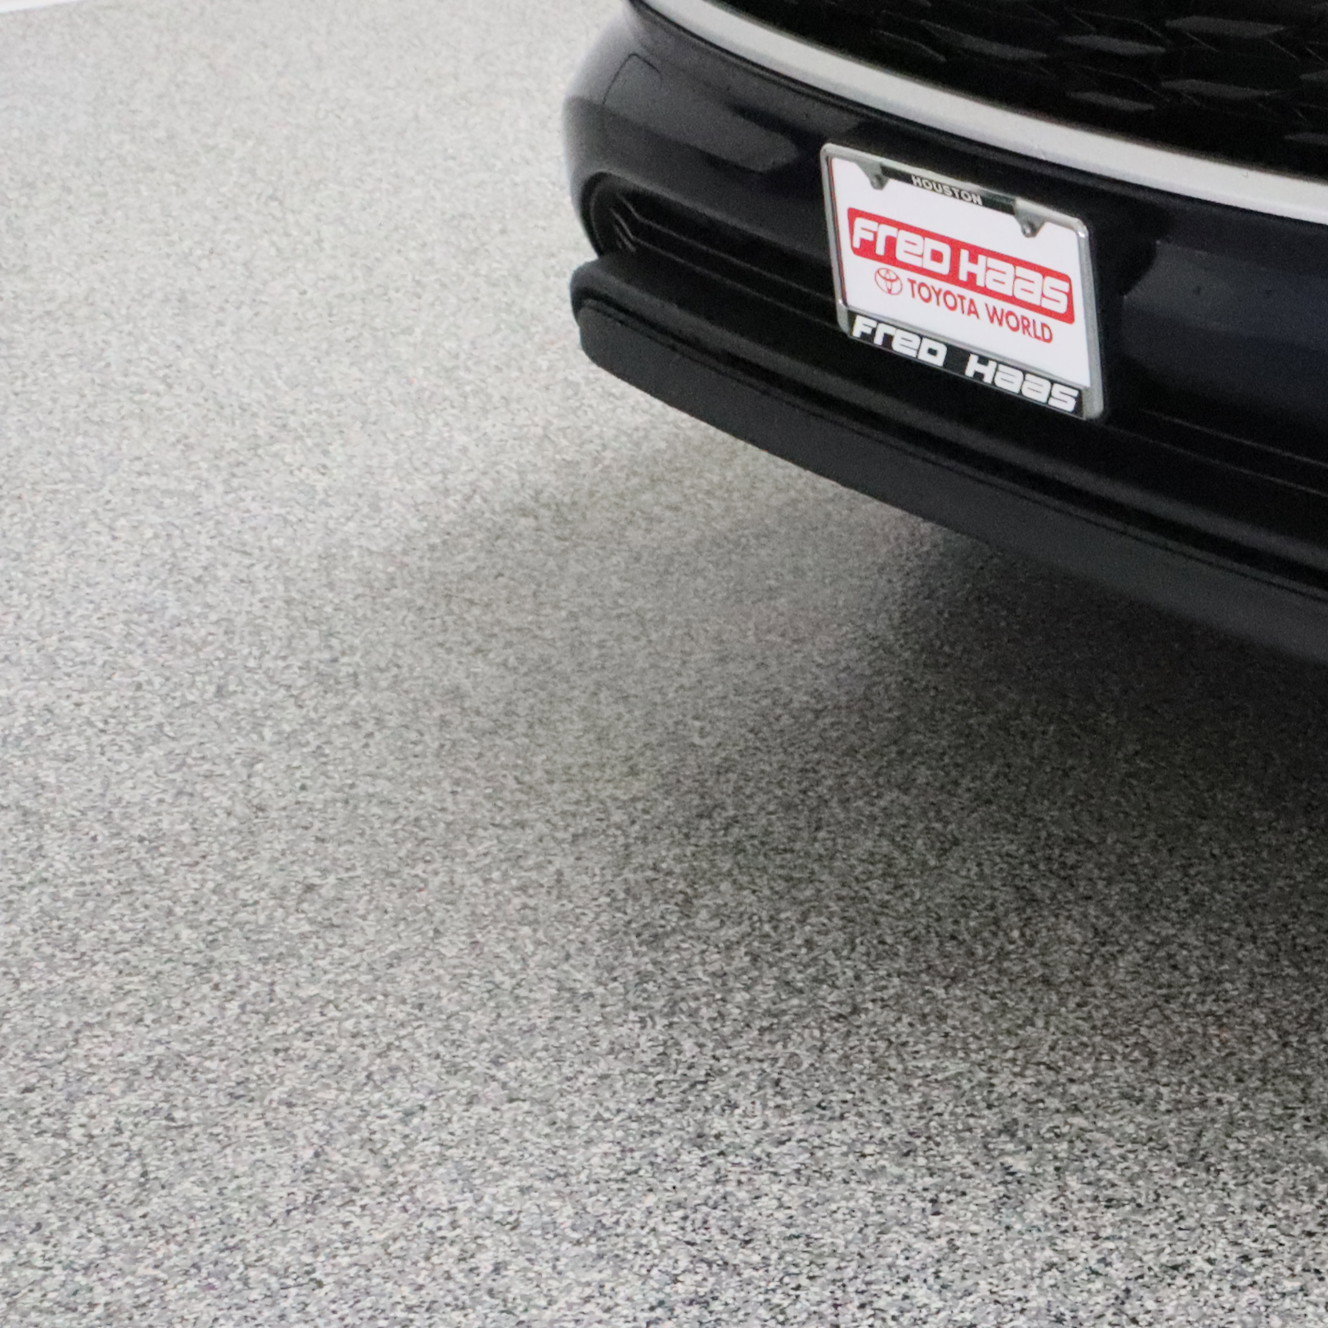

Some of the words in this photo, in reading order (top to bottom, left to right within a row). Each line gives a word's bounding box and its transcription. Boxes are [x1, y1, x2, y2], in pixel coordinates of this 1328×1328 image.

[911, 175, 983, 205] HOUSTON
[907, 279, 979, 320] TOYOTA
[986, 303, 1053, 343] WORLD
